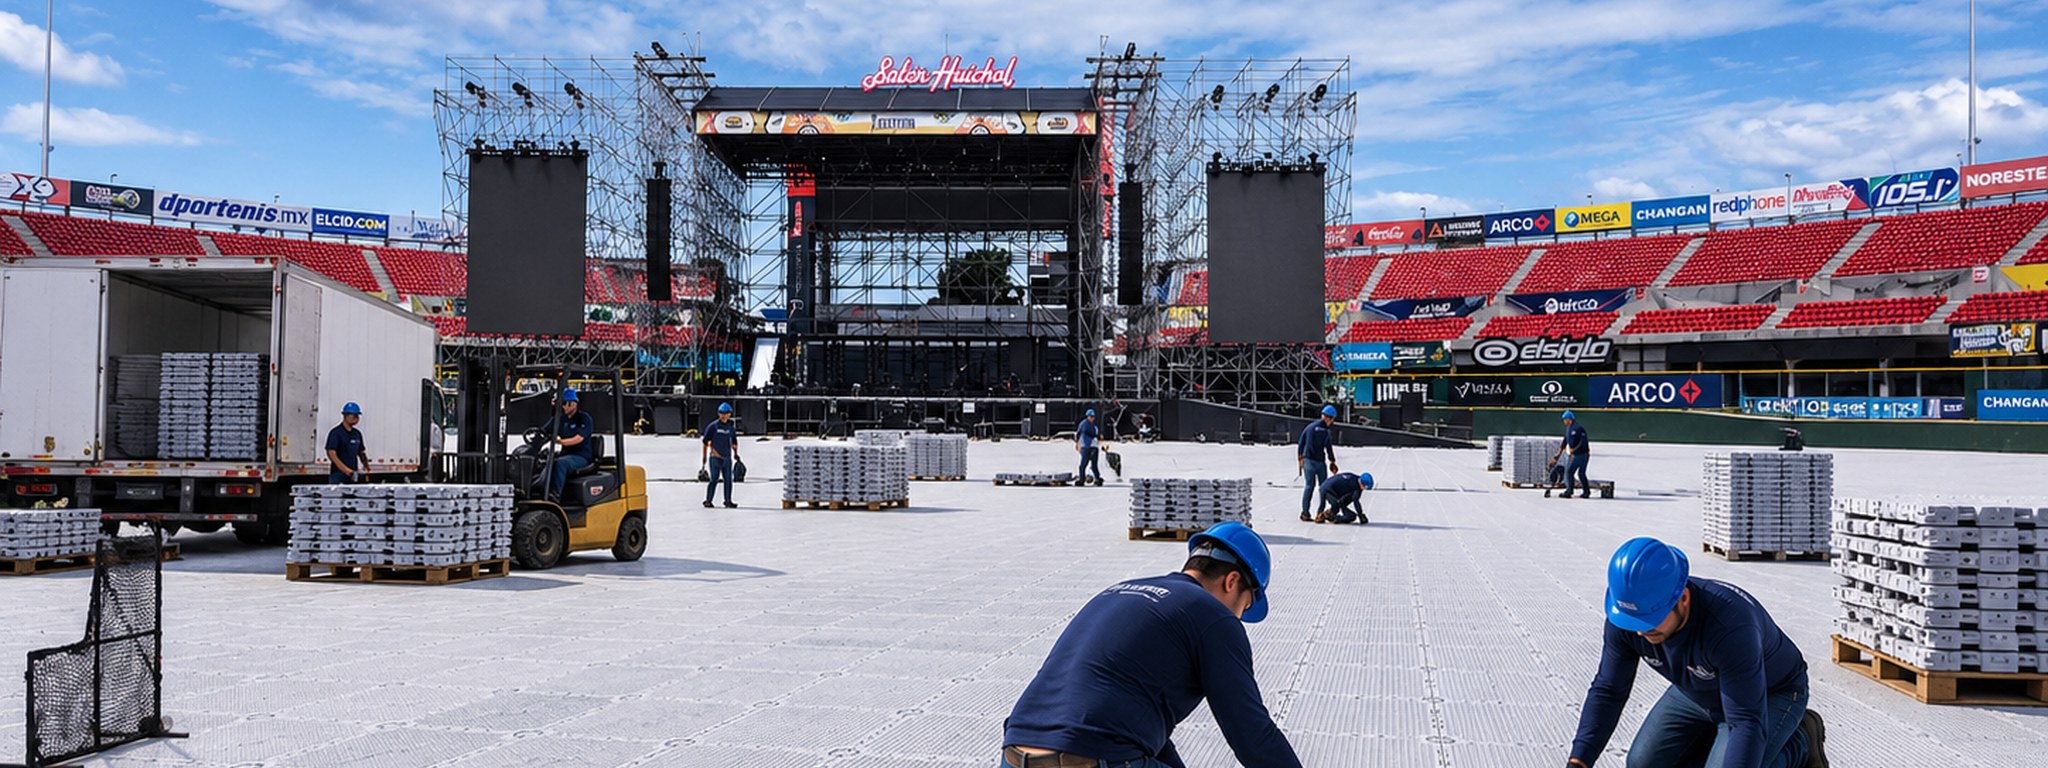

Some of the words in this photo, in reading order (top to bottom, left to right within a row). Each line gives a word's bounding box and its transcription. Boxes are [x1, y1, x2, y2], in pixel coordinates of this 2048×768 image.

[1966, 165, 2048, 188] NORESTE
[158, 193, 309, 225] dportenis.mx
[1636, 204, 1708, 221] CHANGAN
[1713, 194, 1786, 215] redphone
[315, 214, 387, 231] ELCID.COM
[1490, 217, 1534, 234] ARCO
[1581, 210, 1621, 224] MEGA
[1608, 382, 1676, 403] ARCO
[1983, 396, 2048, 408] CHANGAN
